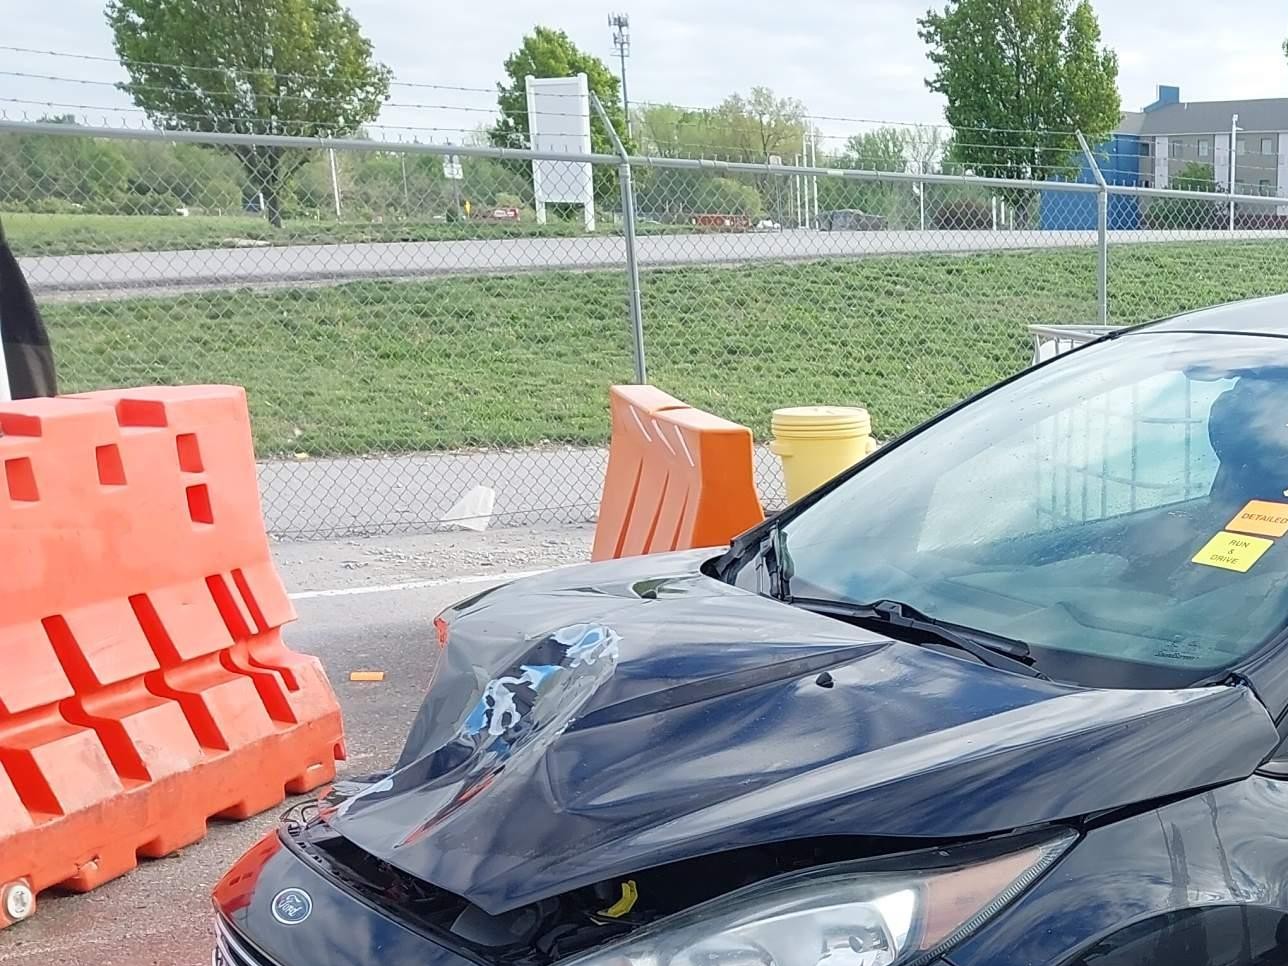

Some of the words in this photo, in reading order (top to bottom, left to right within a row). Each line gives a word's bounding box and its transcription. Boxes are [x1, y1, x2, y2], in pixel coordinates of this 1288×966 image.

[1241, 512, 1288, 525] DETAILED
[1228, 539, 1251, 549] RUN
[1209, 554, 1240, 565] DRIVE
